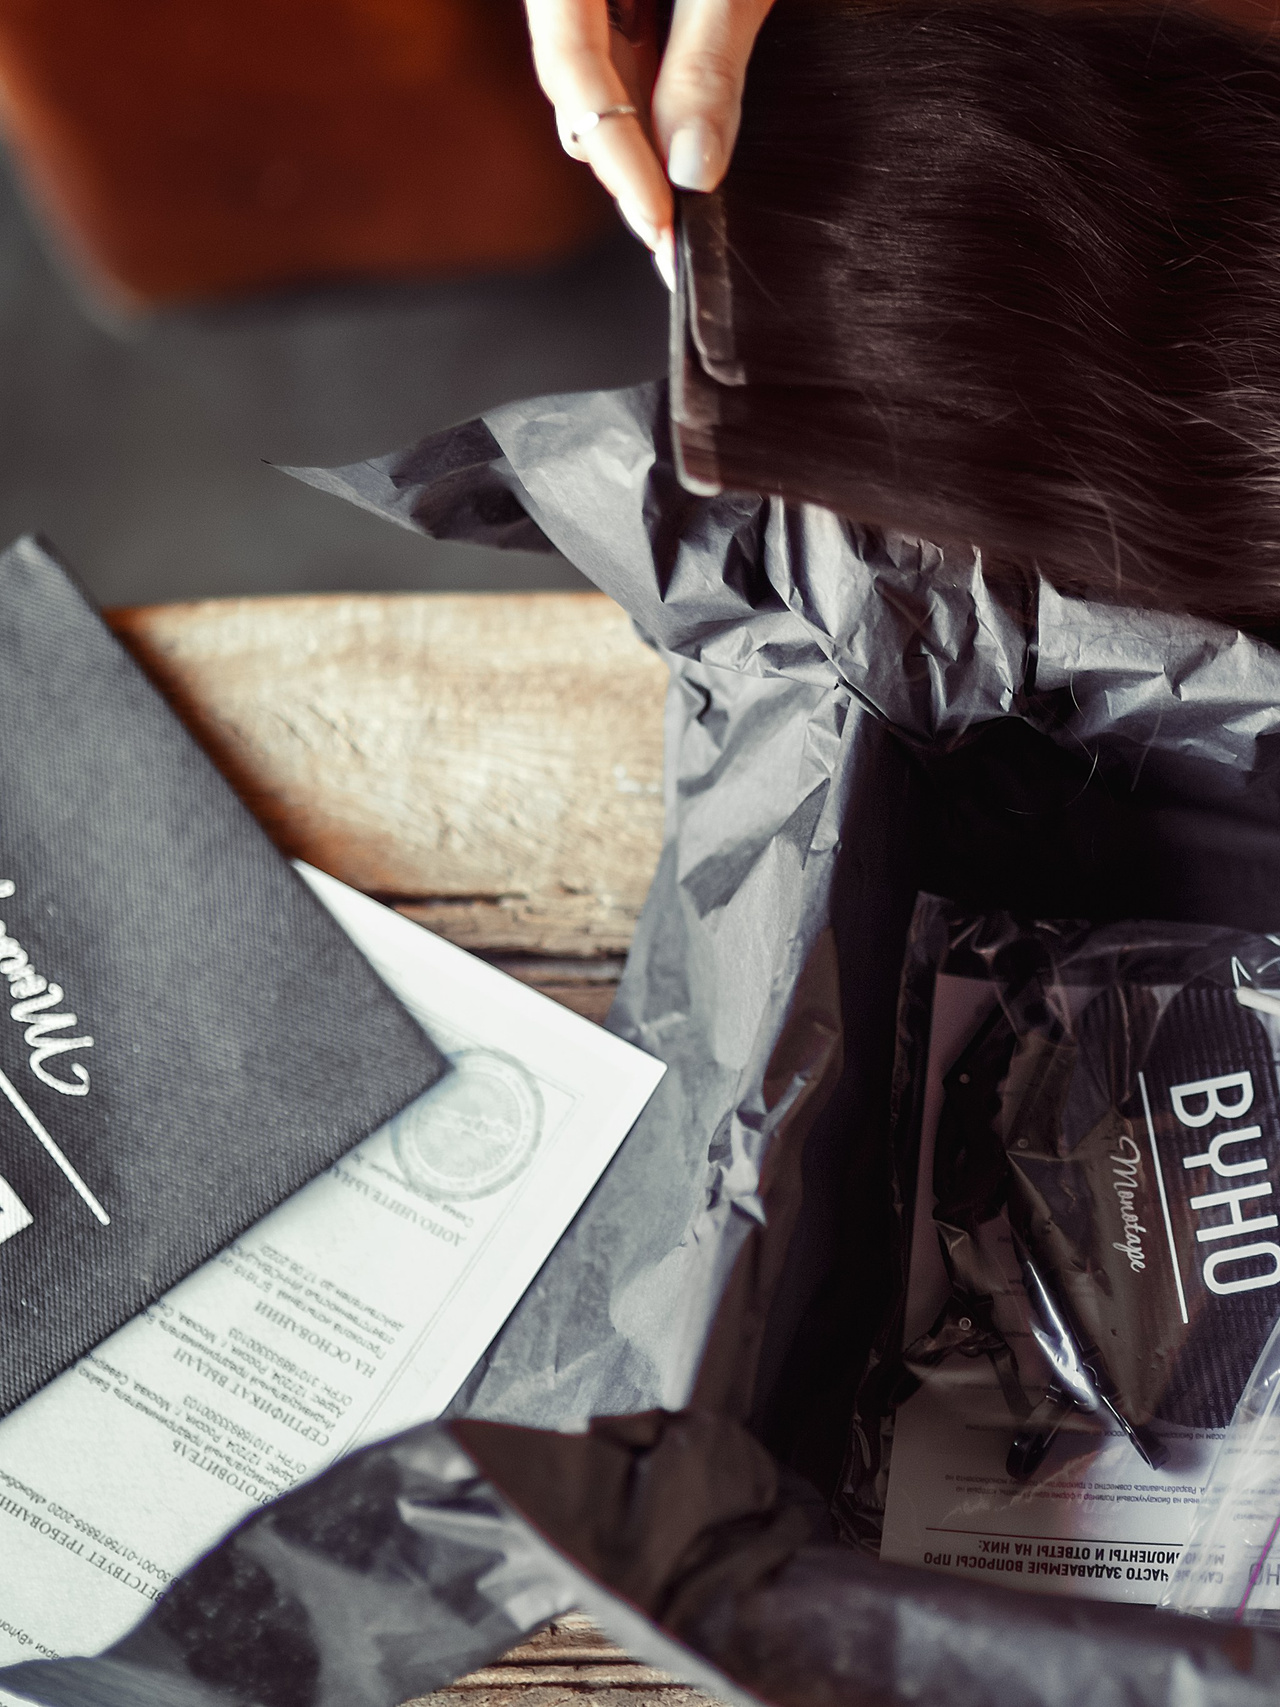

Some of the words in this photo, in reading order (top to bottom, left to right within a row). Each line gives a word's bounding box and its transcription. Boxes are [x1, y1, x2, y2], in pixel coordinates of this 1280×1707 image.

[1109, 1135, 1147, 1273] Monotape
[252, 1298, 353, 1365] ОСНОВАНИИ
[170, 1345, 230, 1388] ВЫДАН
[351, 1357, 377, 1379] НА
[228, 1380, 331, 1447] СЕРТИФИКАТ
[167, 1437, 275, 1508] ЗГОТОВИТЕЛЬ
[977, 1539, 1009, 1553] НИХ:
[1013, 1542, 1031, 1555] НА
[1036, 1543, 1090, 1560] ОТВЕТЫ
[1094, 1547, 1104, 1560] И
[922, 1551, 951, 1565] ПРО
[955, 1554, 1023, 1572] ВОПРОСЫ
[1027, 1558, 1122, 1579] ЗАДАВАЕМЫЕ
[84, 1549, 166, 1605] ВЕТСТВУЕТ
[1125, 1566, 1169, 1582] ЧАСТО
[33, 1640, 62, 1663] арки
